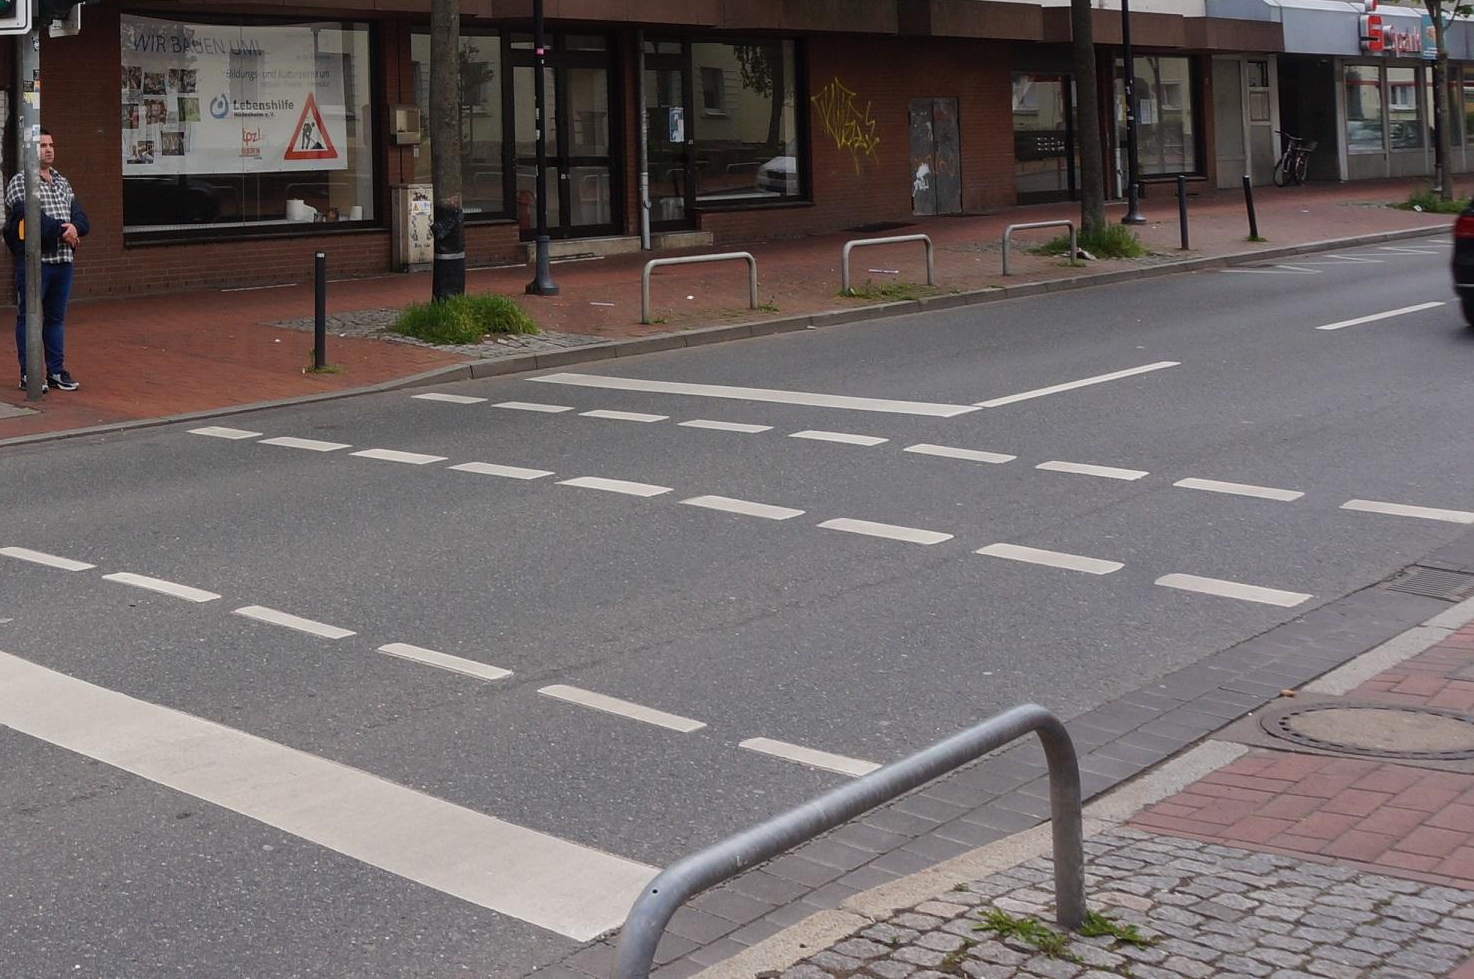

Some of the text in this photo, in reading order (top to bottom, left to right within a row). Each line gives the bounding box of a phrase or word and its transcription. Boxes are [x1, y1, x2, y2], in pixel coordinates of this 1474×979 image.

[134, 35, 262, 56] WIR BAUEN UM!
[233, 100, 294, 110] Lebenshilfe
